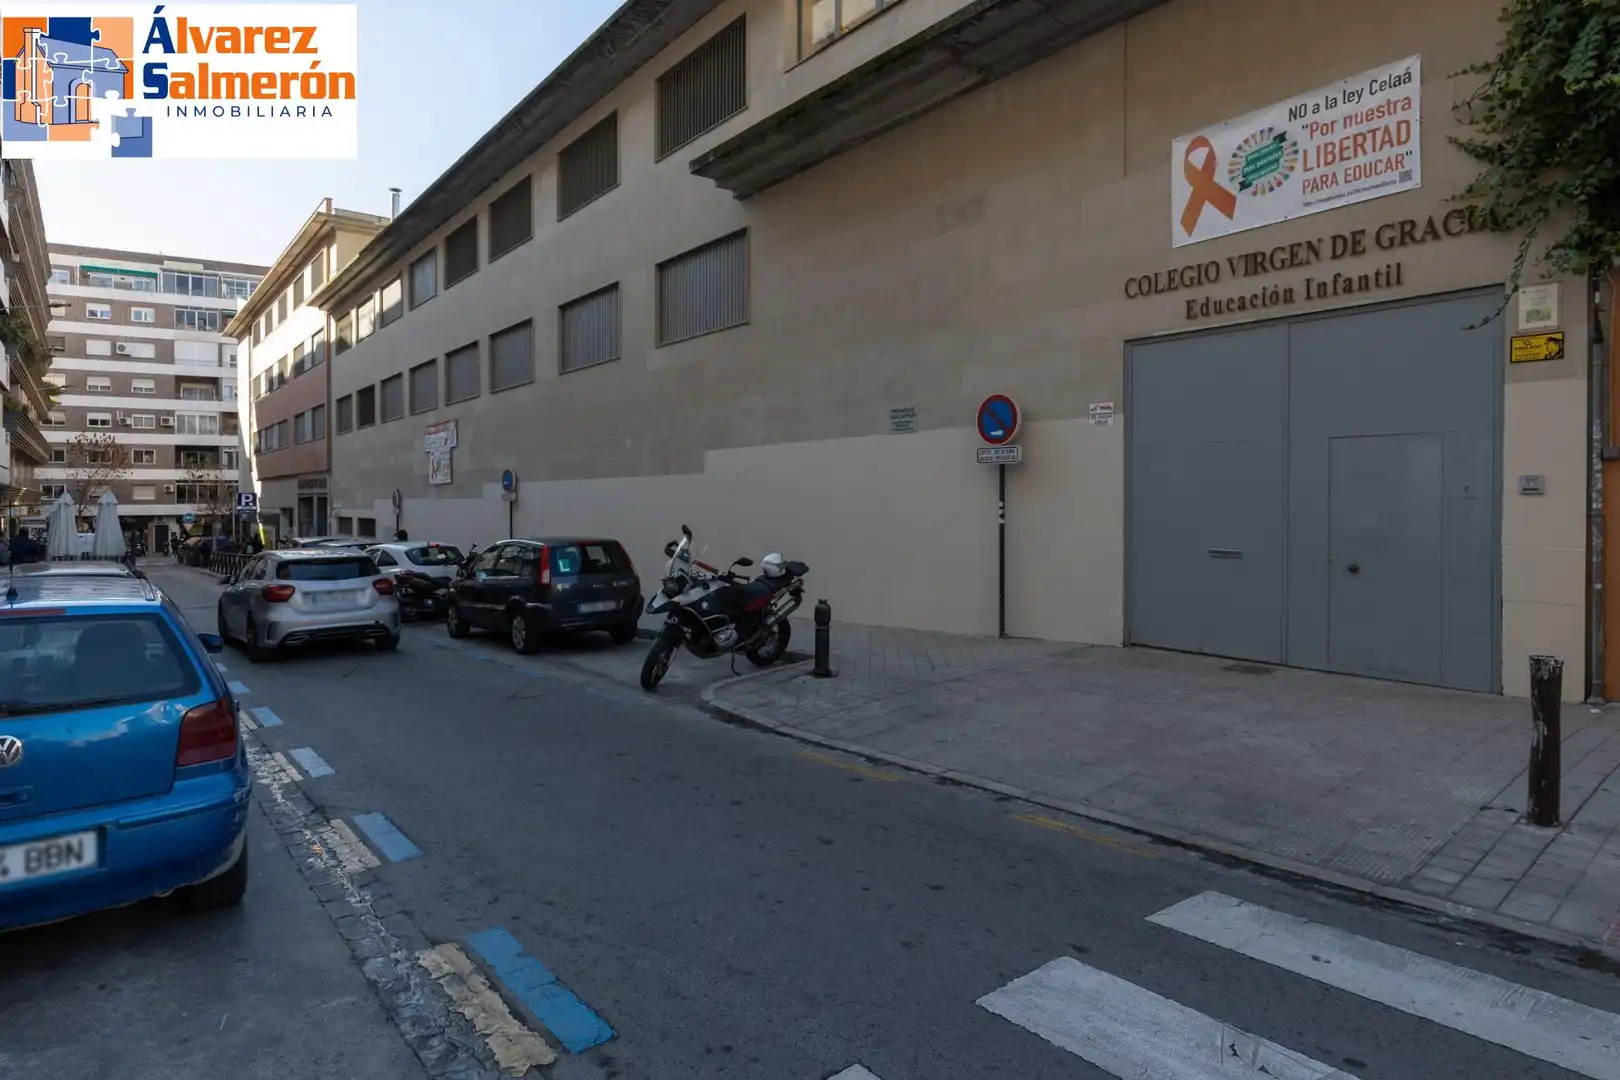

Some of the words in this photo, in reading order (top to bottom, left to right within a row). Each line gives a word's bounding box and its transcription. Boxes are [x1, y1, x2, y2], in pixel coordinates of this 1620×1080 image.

[1288, 102, 1308, 123] NO
[1312, 103, 1320, 115] a
[1325, 95, 1338, 110] la
[1342, 87, 1364, 105] ley
[1369, 66, 1412, 96] Celaá
[1342, 96, 1412, 131] nuestra
[1303, 119, 1411, 172] LIBERTAD
[1302, 171, 1339, 195] PARA
[1344, 150, 1412, 184] EDUCAR"
[1125, 260, 1220, 299] COLEGIO
[1227, 238, 1323, 278] VIRGEN
[1330, 229, 1367, 260] DE
[1185, 284, 1295, 320] Educación
[1304, 262, 1404, 300] Infantil
[241, 493, 253, 506] P
[558, 560, 570, 572] L
